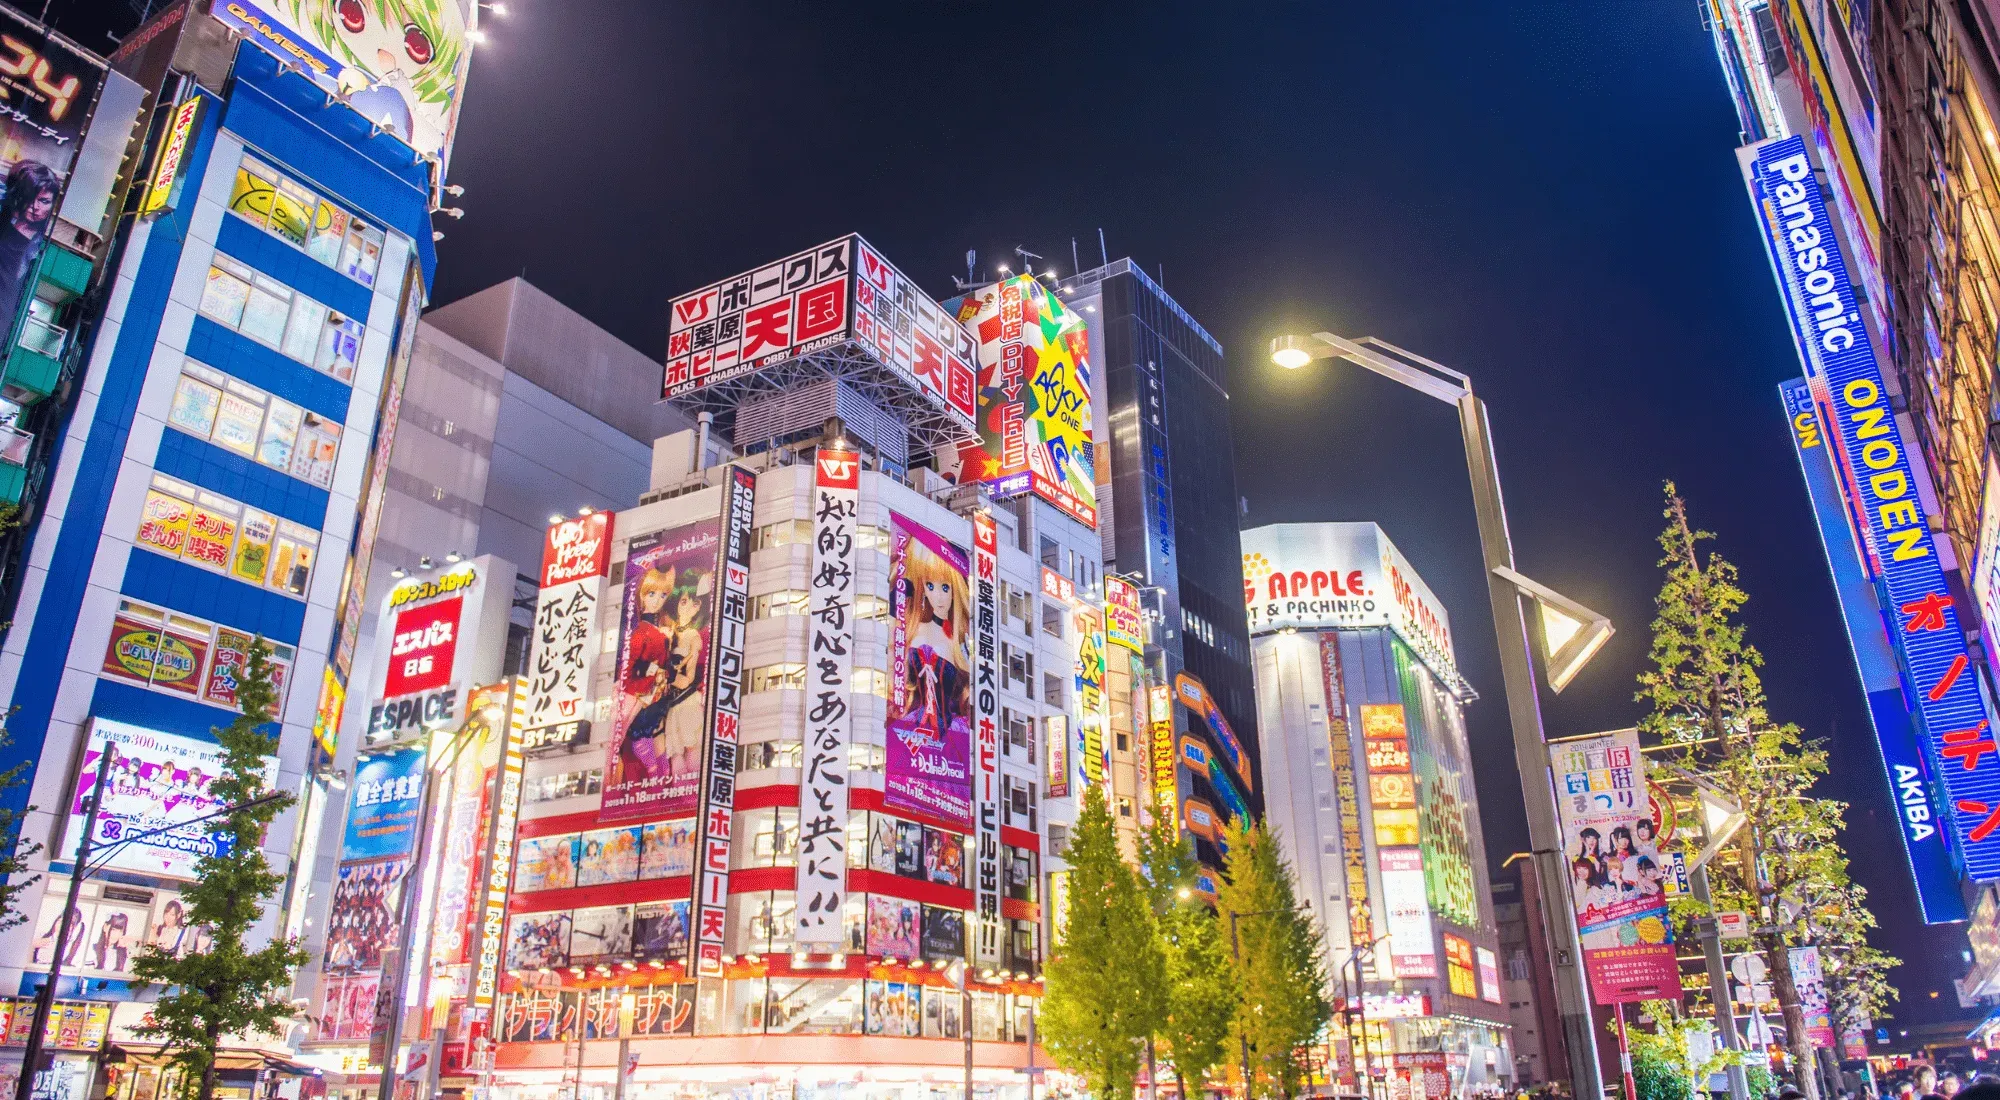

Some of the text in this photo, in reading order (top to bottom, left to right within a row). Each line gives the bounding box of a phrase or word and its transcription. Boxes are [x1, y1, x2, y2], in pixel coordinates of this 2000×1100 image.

[226, 3, 330, 75] GAMERS
[720, 243, 847, 312] ボークス
[1768, 153, 1854, 353] Panasonic
[743, 277, 845, 361] 天国
[856, 276, 912, 340] 秋葉原
[856, 309, 910, 361] ホビー
[896, 280, 975, 368] ボークス
[1001, 286, 1023, 340] 免税店
[669, 316, 740, 358] 秋葉原
[666, 348, 738, 386] ホビー
[913, 328, 975, 417] 天国
[1002, 343, 1024, 401] DUTY
[1003, 404, 1025, 468] FREE
[1061, 411, 1080, 432] ONE
[1843, 379, 1929, 563] ONODEN
[1045, 572, 1072, 599] 免税
[1287, 599, 1376, 614] PACHINKO
[120, 641, 192, 671] WELCOME
[393, 620, 453, 655] エスパス
[1079, 613, 1099, 684] TAX
[368, 690, 456, 736] ESPACE
[800, 491, 856, 928] 知的好奇心をあなたと共に!!
[1186, 744, 1205, 765] SEGA
[1563, 746, 1632, 773] 秋葉原
[1588, 739, 1616, 751] WINTER
[1573, 789, 1634, 814] まつり
[1894, 764, 1934, 842] AKIBA
